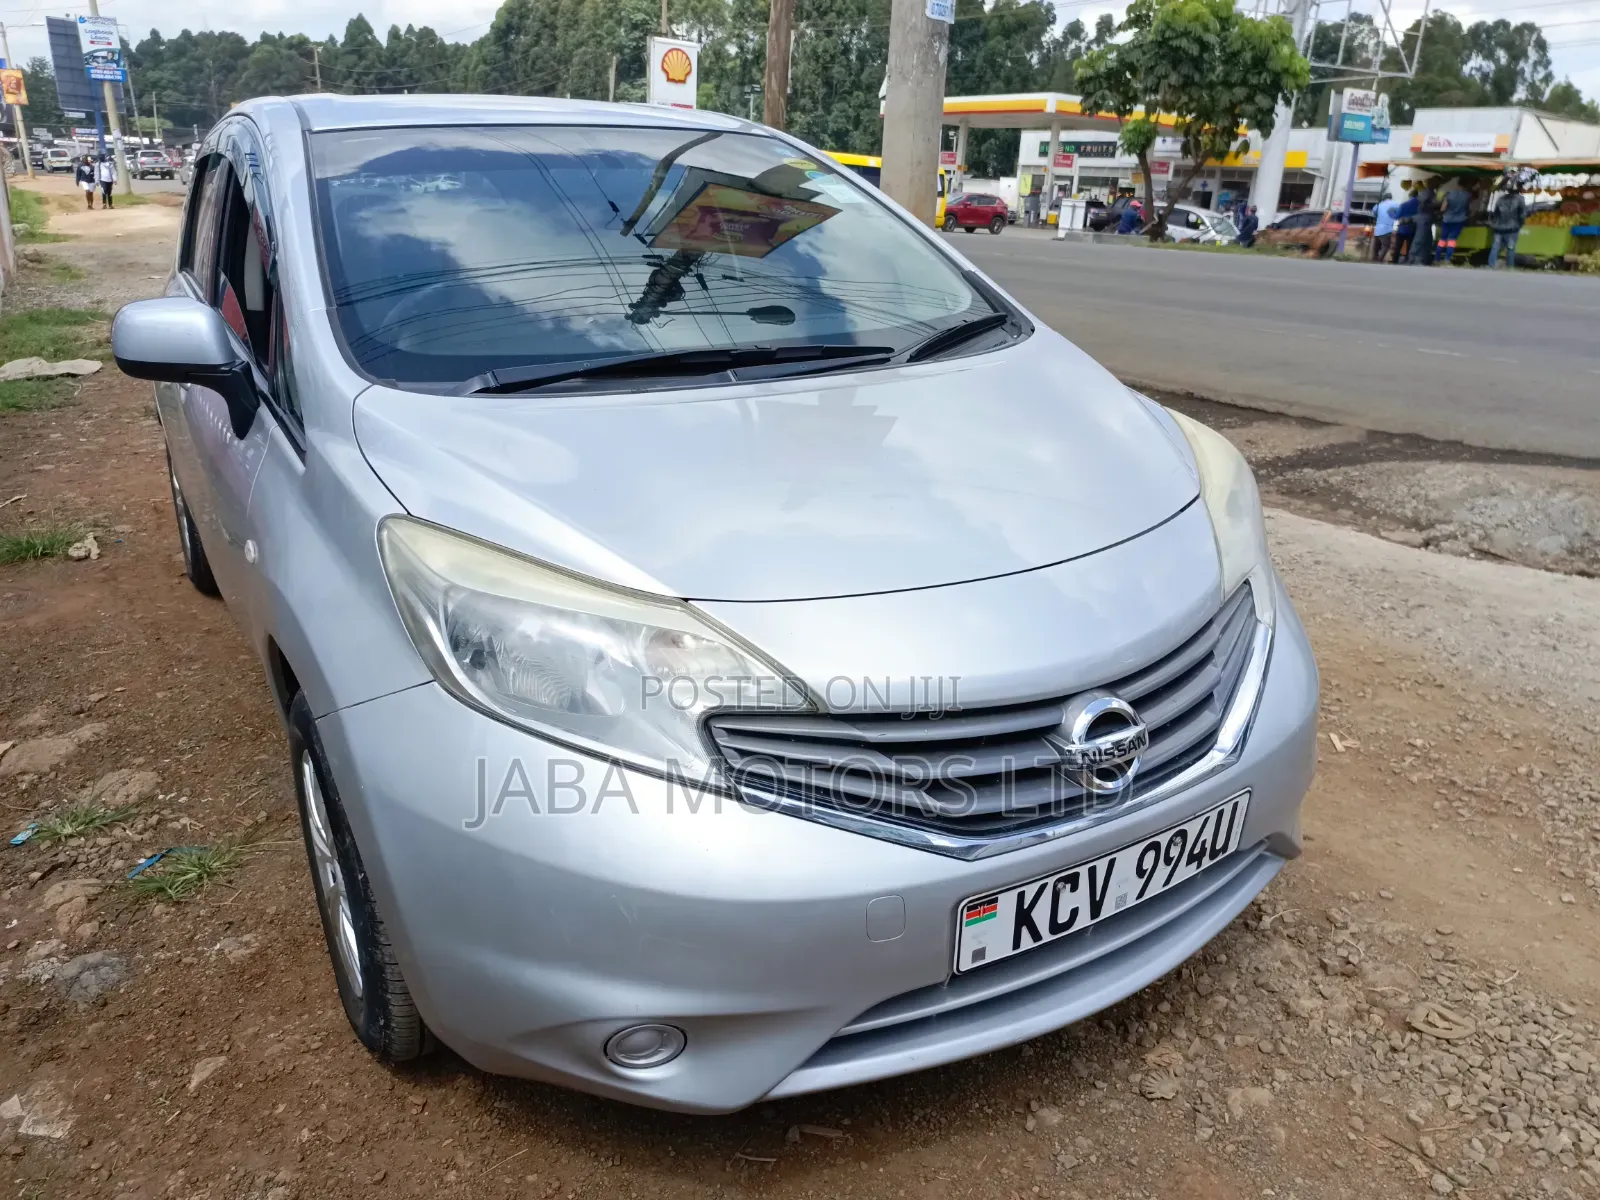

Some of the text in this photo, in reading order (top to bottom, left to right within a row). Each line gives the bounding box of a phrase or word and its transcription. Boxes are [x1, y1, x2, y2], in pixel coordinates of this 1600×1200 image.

[1080, 145, 1114, 153] FRUITS
[1081, 732, 1147, 765] NISSAN
[1012, 801, 1240, 951] KCV 994U
